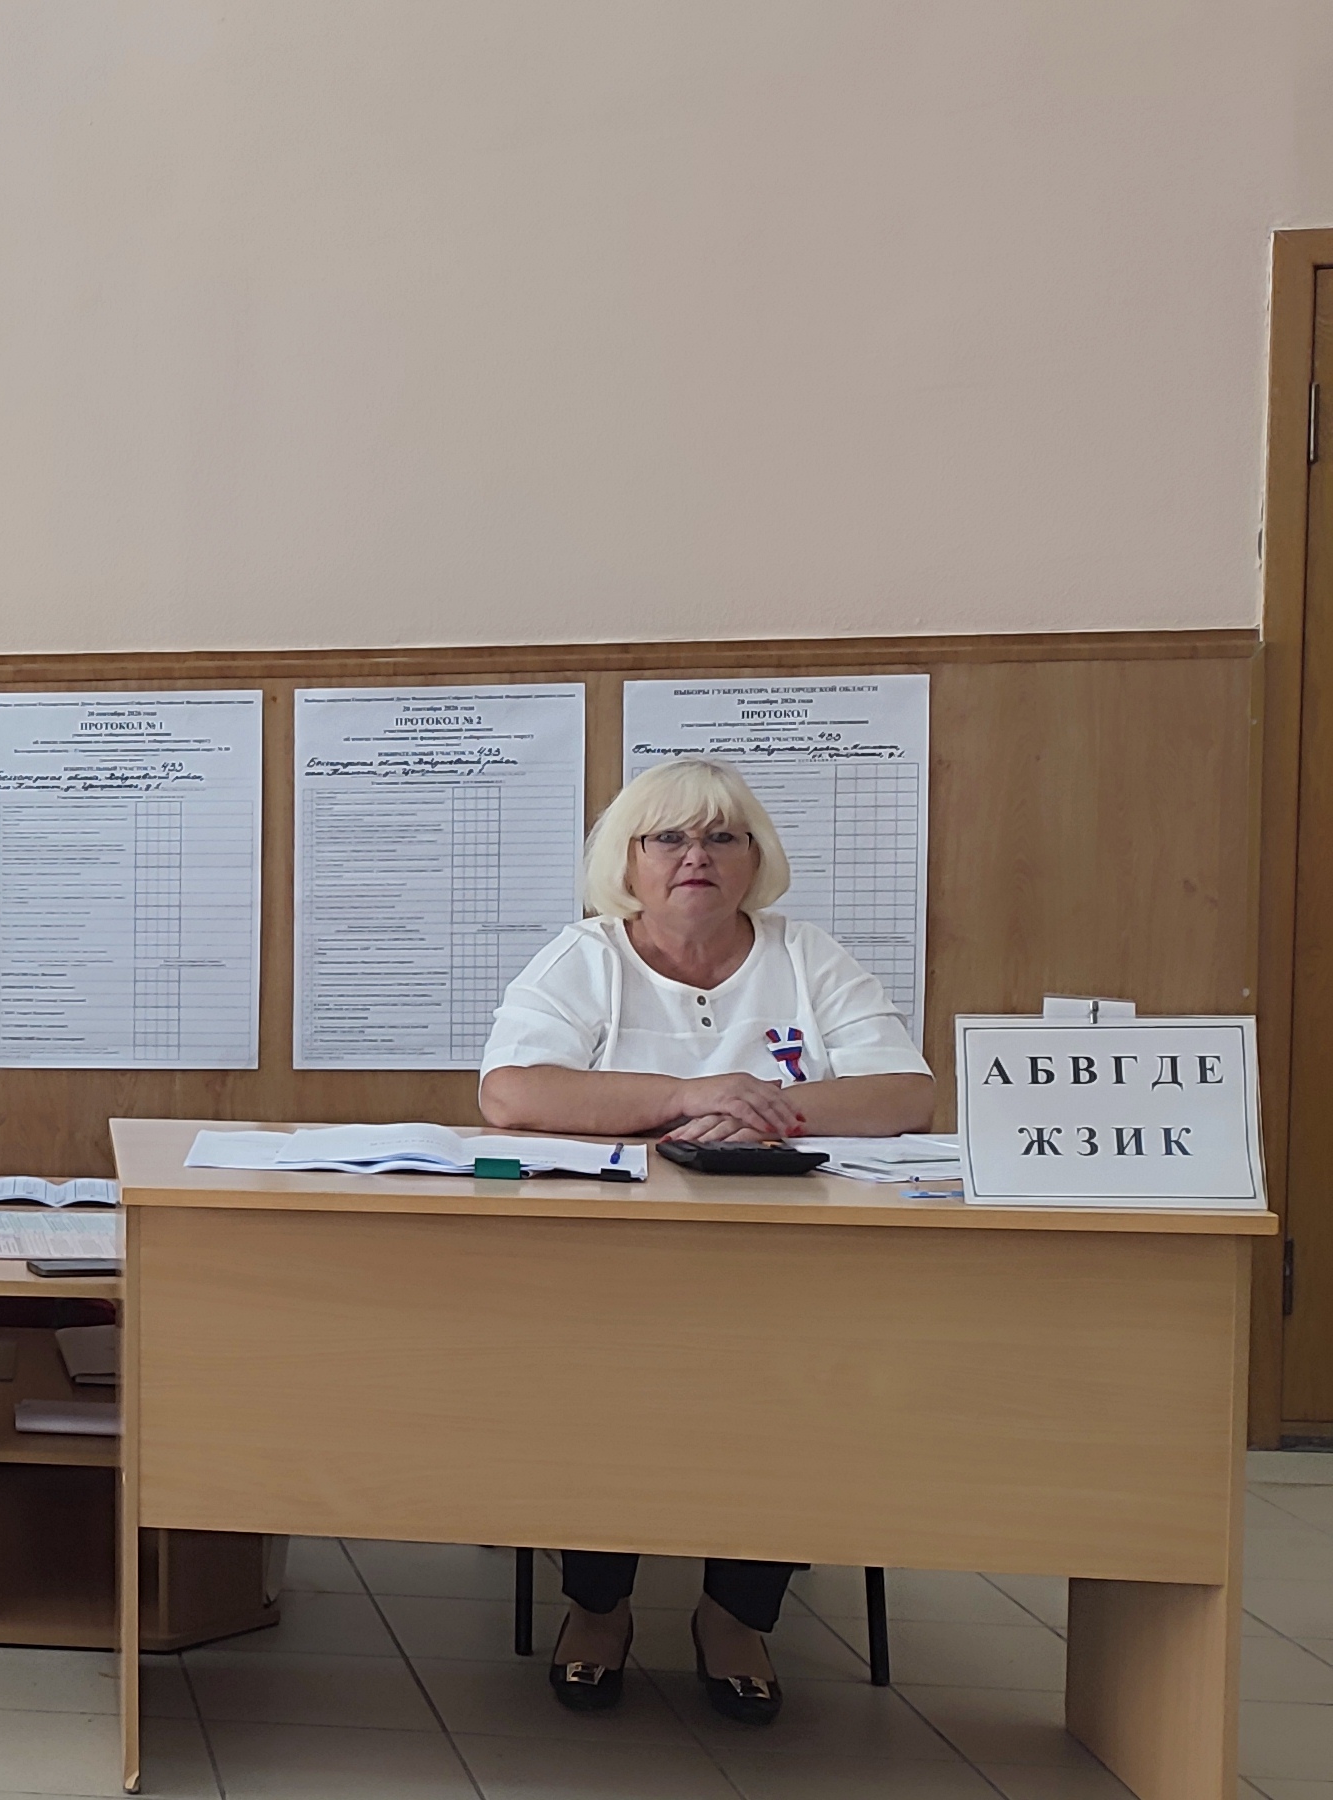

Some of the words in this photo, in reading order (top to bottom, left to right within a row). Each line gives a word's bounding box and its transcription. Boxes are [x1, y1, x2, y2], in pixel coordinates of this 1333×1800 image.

[741, 708, 809, 719] ПРОТОКОЛ
[80, 721, 143, 731] ПРОТОКОЛ
[145, 721, 156, 730] №
[395, 716, 460, 726] ПРОТОКОЛ
[462, 716, 474, 725] №
[476, 716, 482, 725] 2
[160, 761, 184, 772] 433
